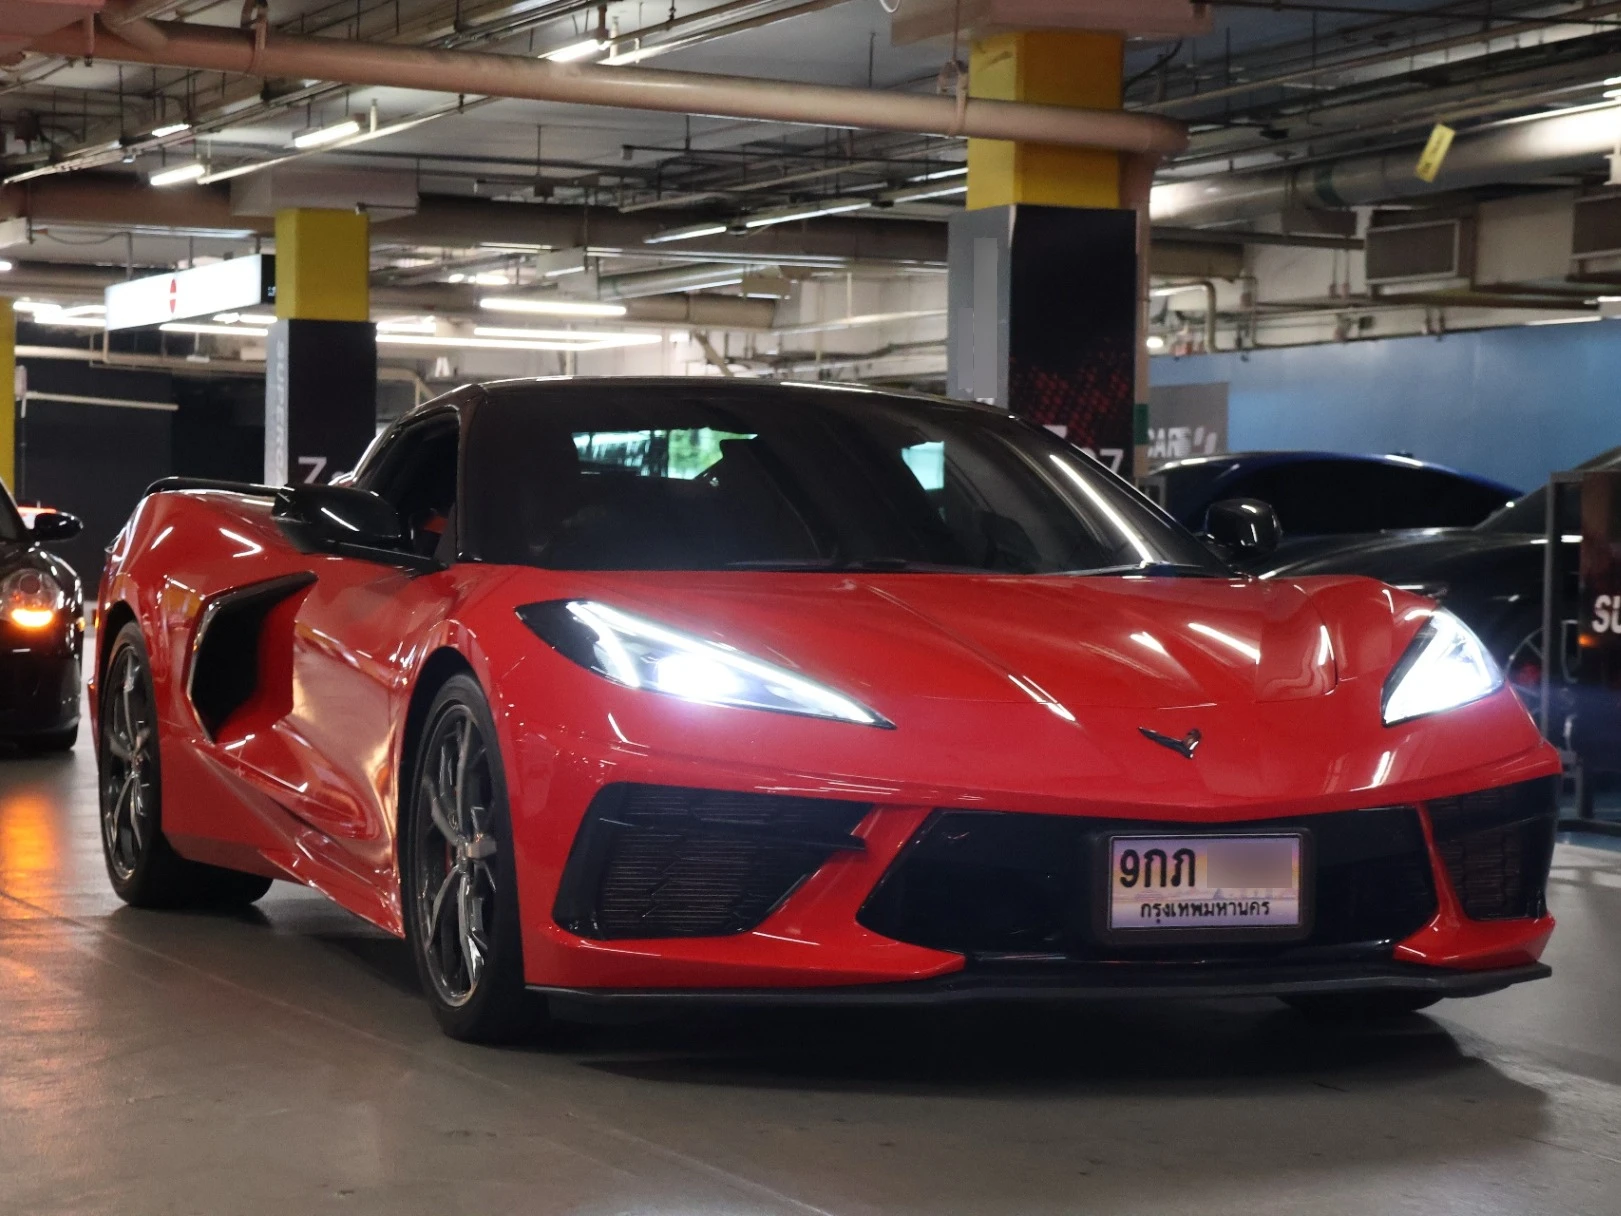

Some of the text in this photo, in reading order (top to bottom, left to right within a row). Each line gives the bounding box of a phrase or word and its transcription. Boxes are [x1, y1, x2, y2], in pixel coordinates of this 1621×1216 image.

[1140, 900, 1271, 924] กรุงเทพมหานคร
